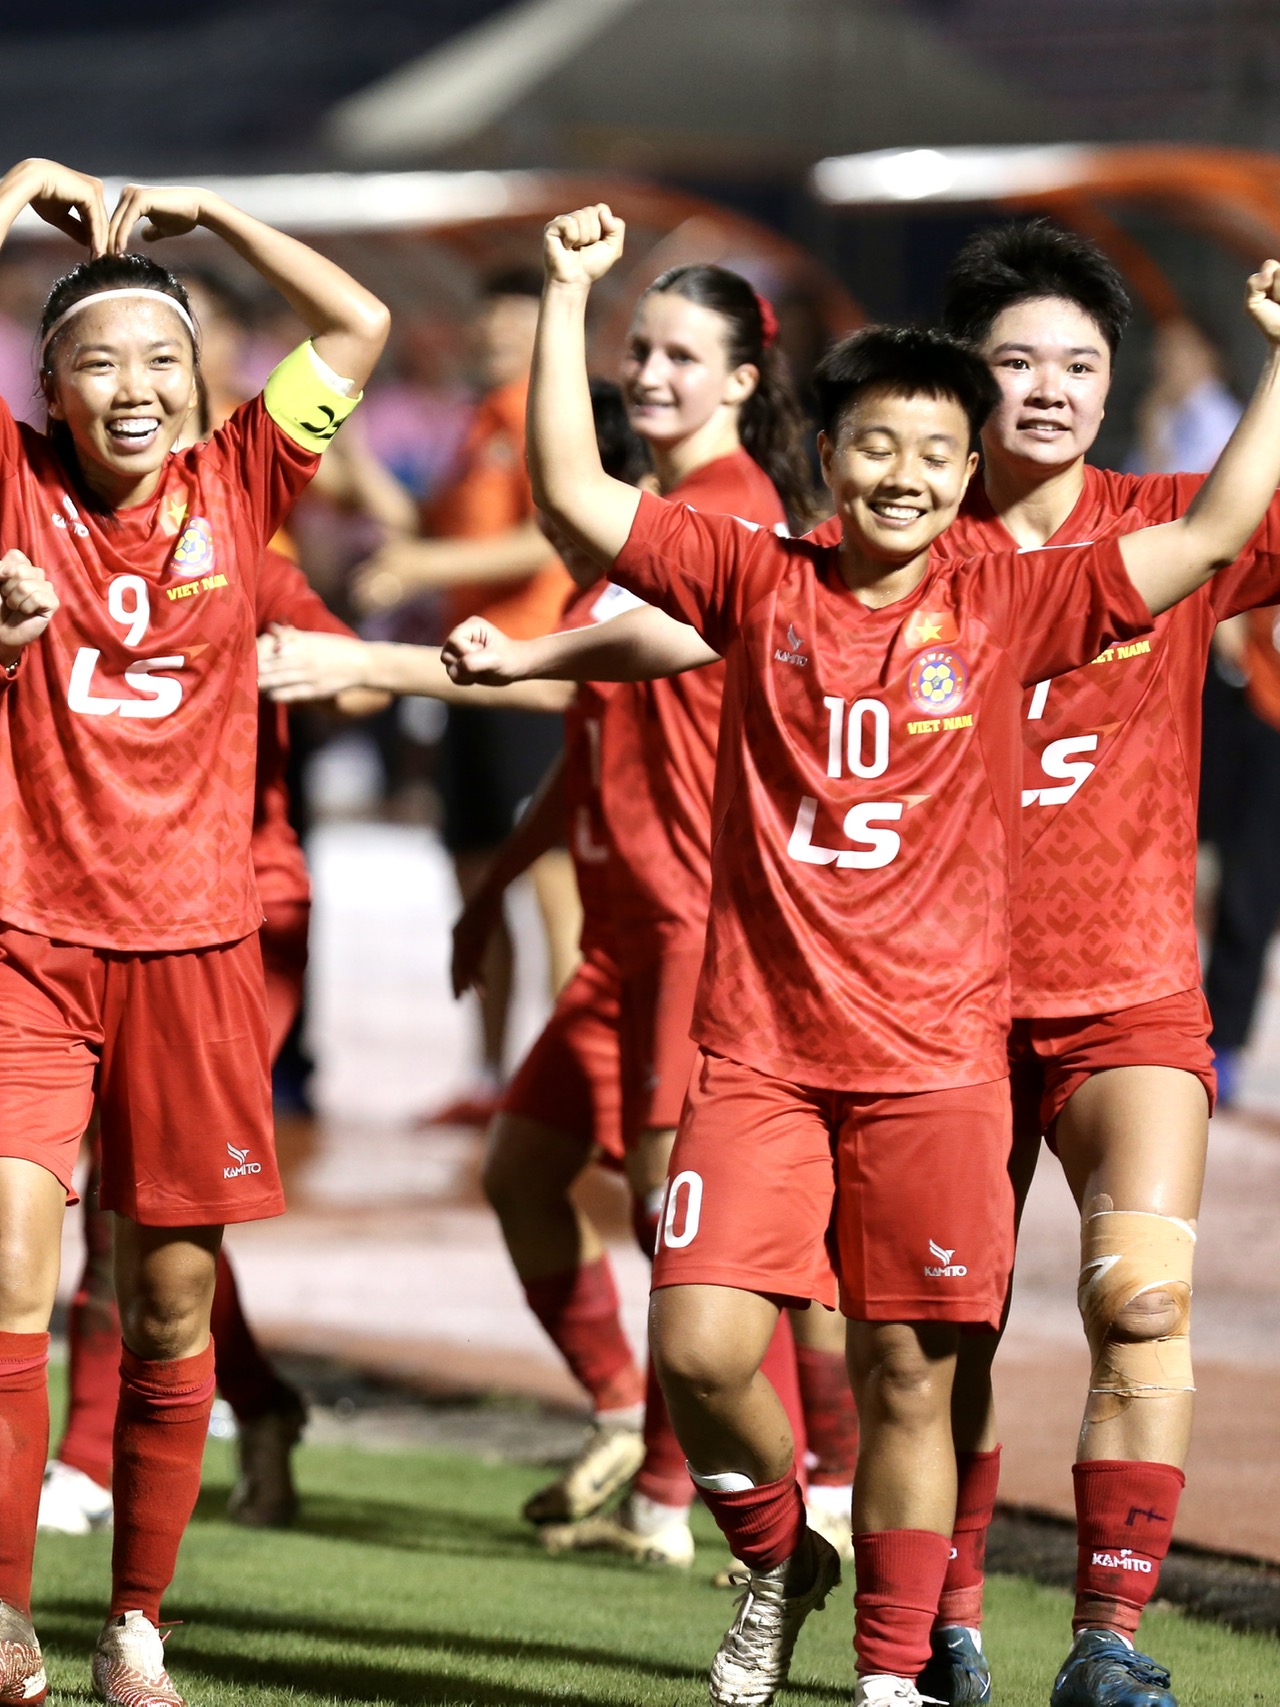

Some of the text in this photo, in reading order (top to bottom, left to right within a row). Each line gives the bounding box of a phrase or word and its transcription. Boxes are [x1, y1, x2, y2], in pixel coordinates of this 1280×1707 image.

[166, 581, 200, 601] VIET
[108, 575, 151, 648] 9
[1116, 640, 1151, 660] NAM
[67, 648, 185, 719] LS
[907, 714, 974, 735] VIET NAM
[823, 696, 890, 779] 10
[1021, 734, 1099, 808] S
[786, 796, 903, 870] LS
[223, 1162, 262, 1179] KAMITO
[924, 1265, 968, 1278] KAMITO
[1091, 1552, 1153, 1574] KAMITO
